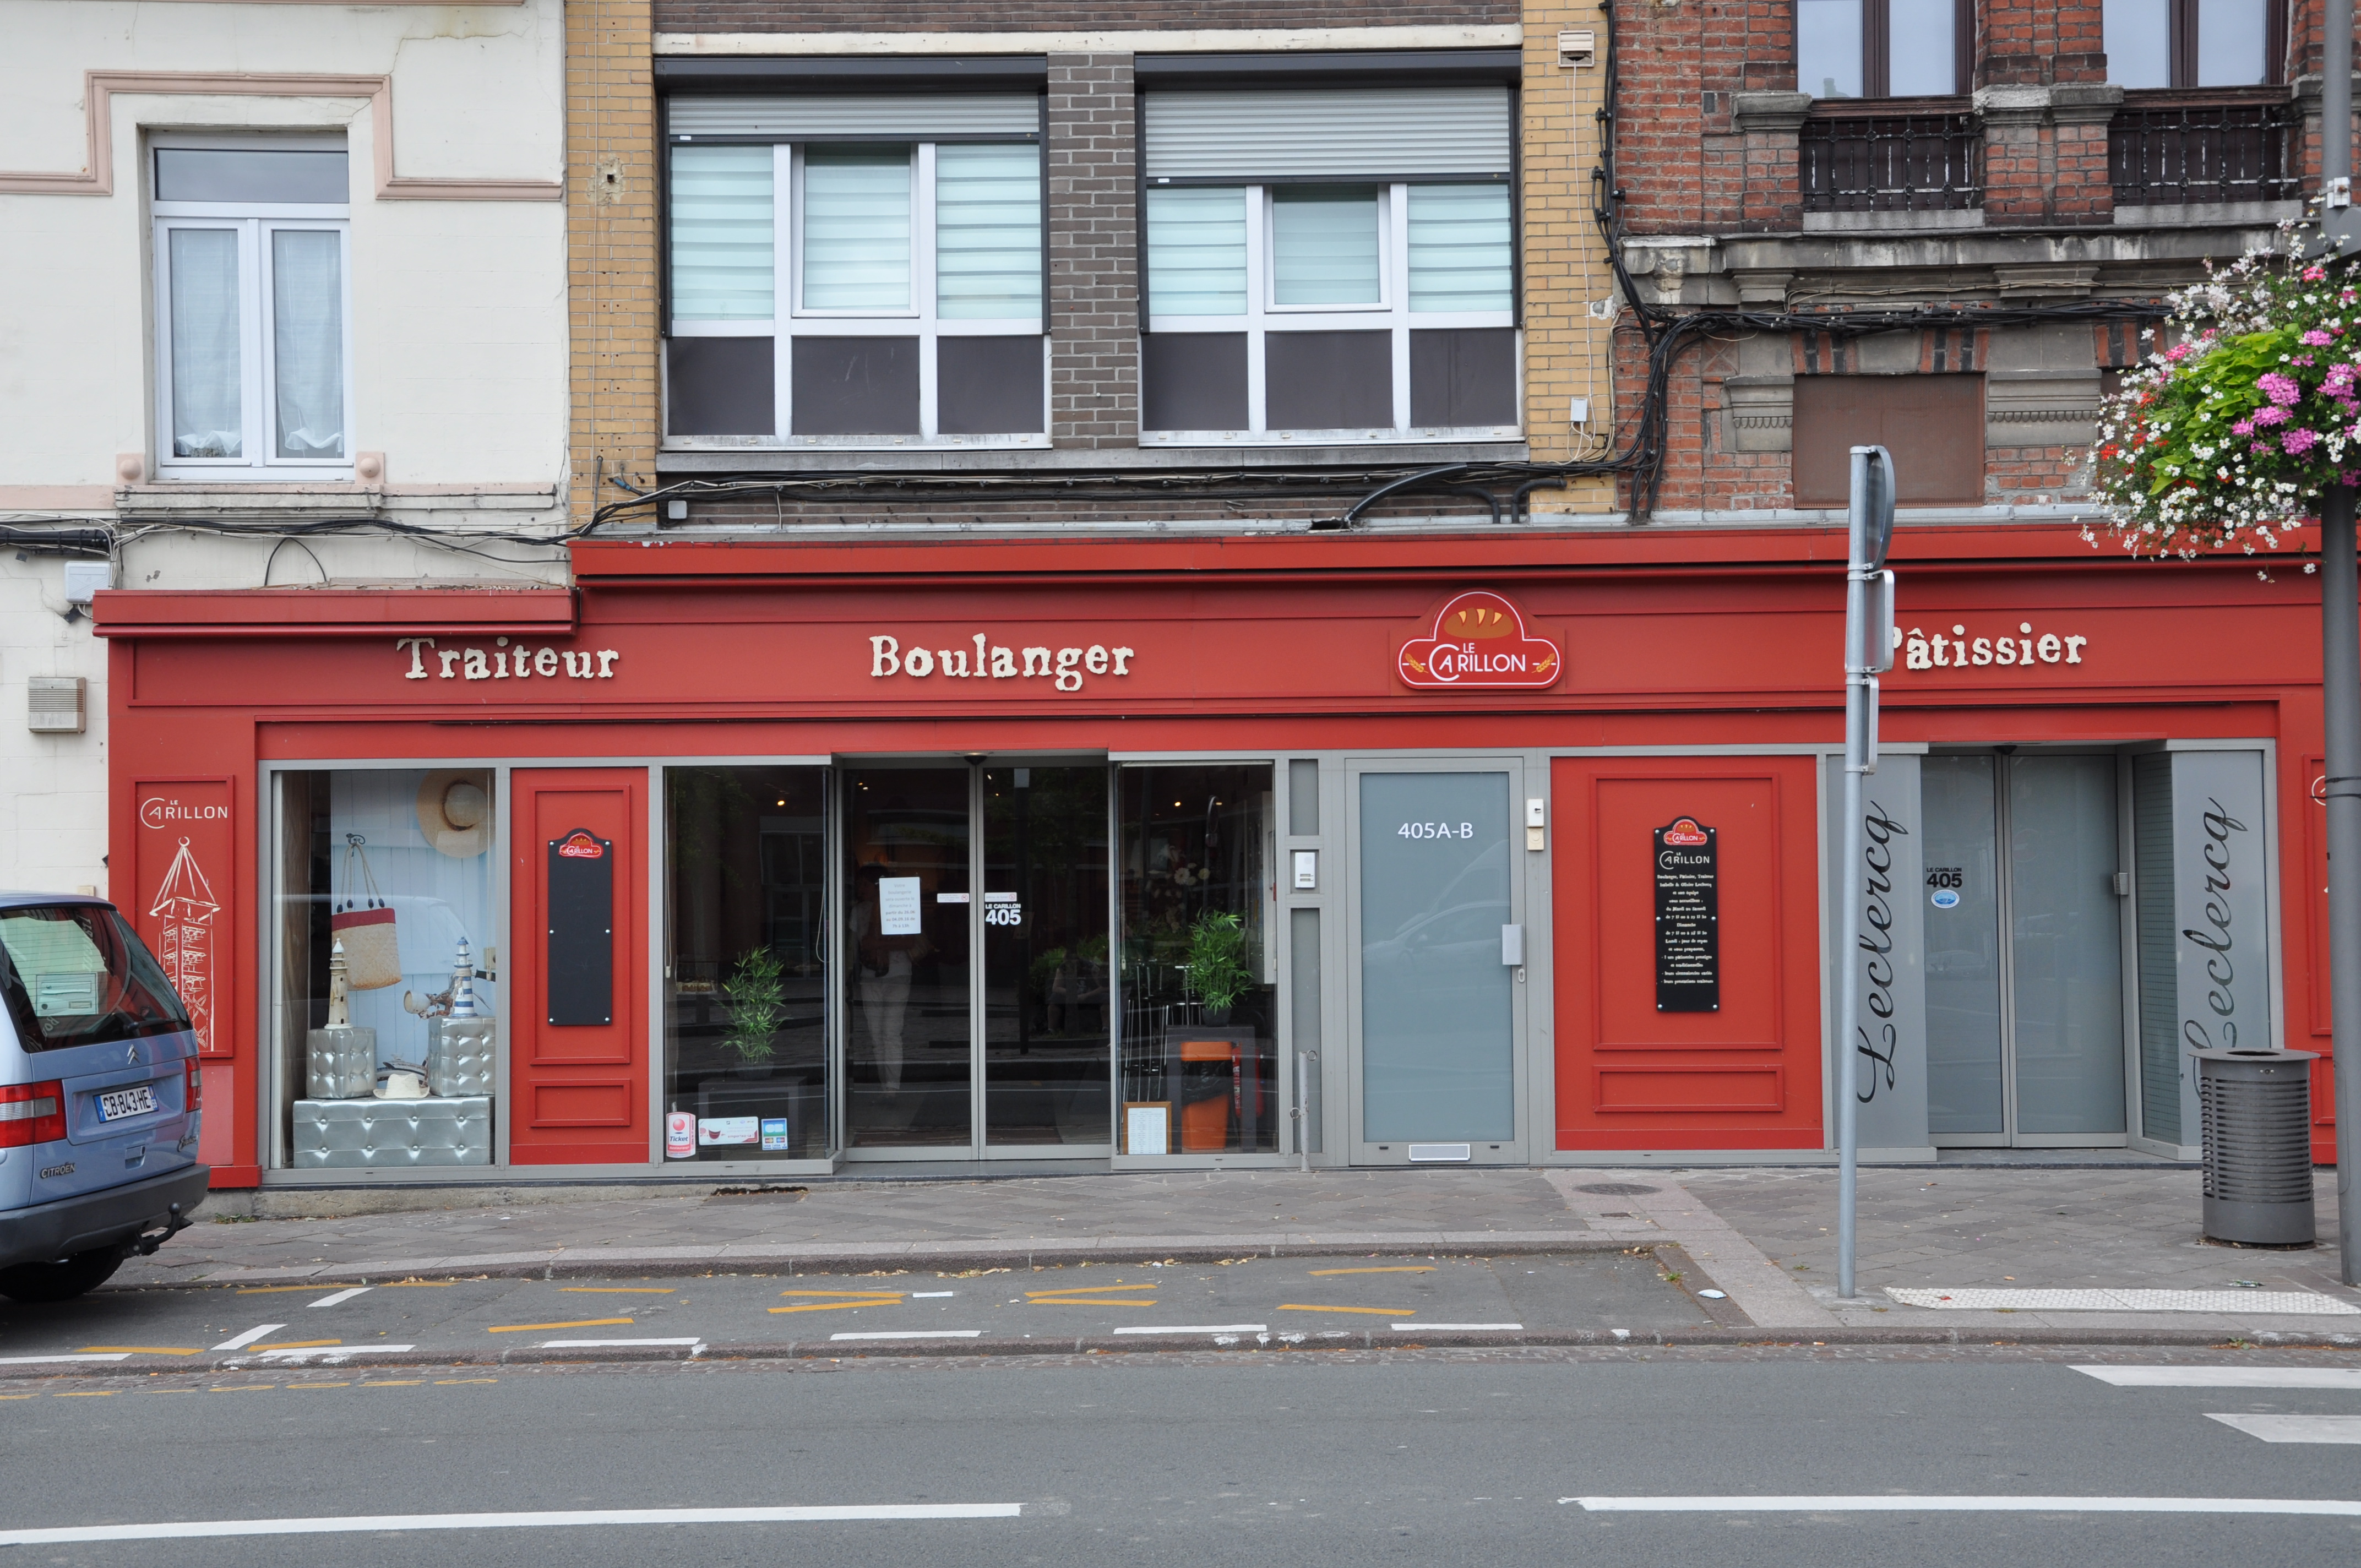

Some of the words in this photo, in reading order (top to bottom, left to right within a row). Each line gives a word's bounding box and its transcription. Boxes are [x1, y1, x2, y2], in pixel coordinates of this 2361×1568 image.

[396, 636, 619, 679] Traiteur
[1463, 643, 1475, 654] LE
[869, 633, 1134, 691] Boulanger
[1429, 644, 1526, 682] CARILLON
[140, 797, 228, 829] CARILLON
[1397, 823, 1473, 839] 405A-B
[1660, 851, 1710, 869] CARILLON
[1927, 873, 1962, 888] 405
[986, 909, 1021, 925] 405
[1858, 801, 1909, 1103] Leclercq
[40, 1162, 75, 1179] CITROËN
